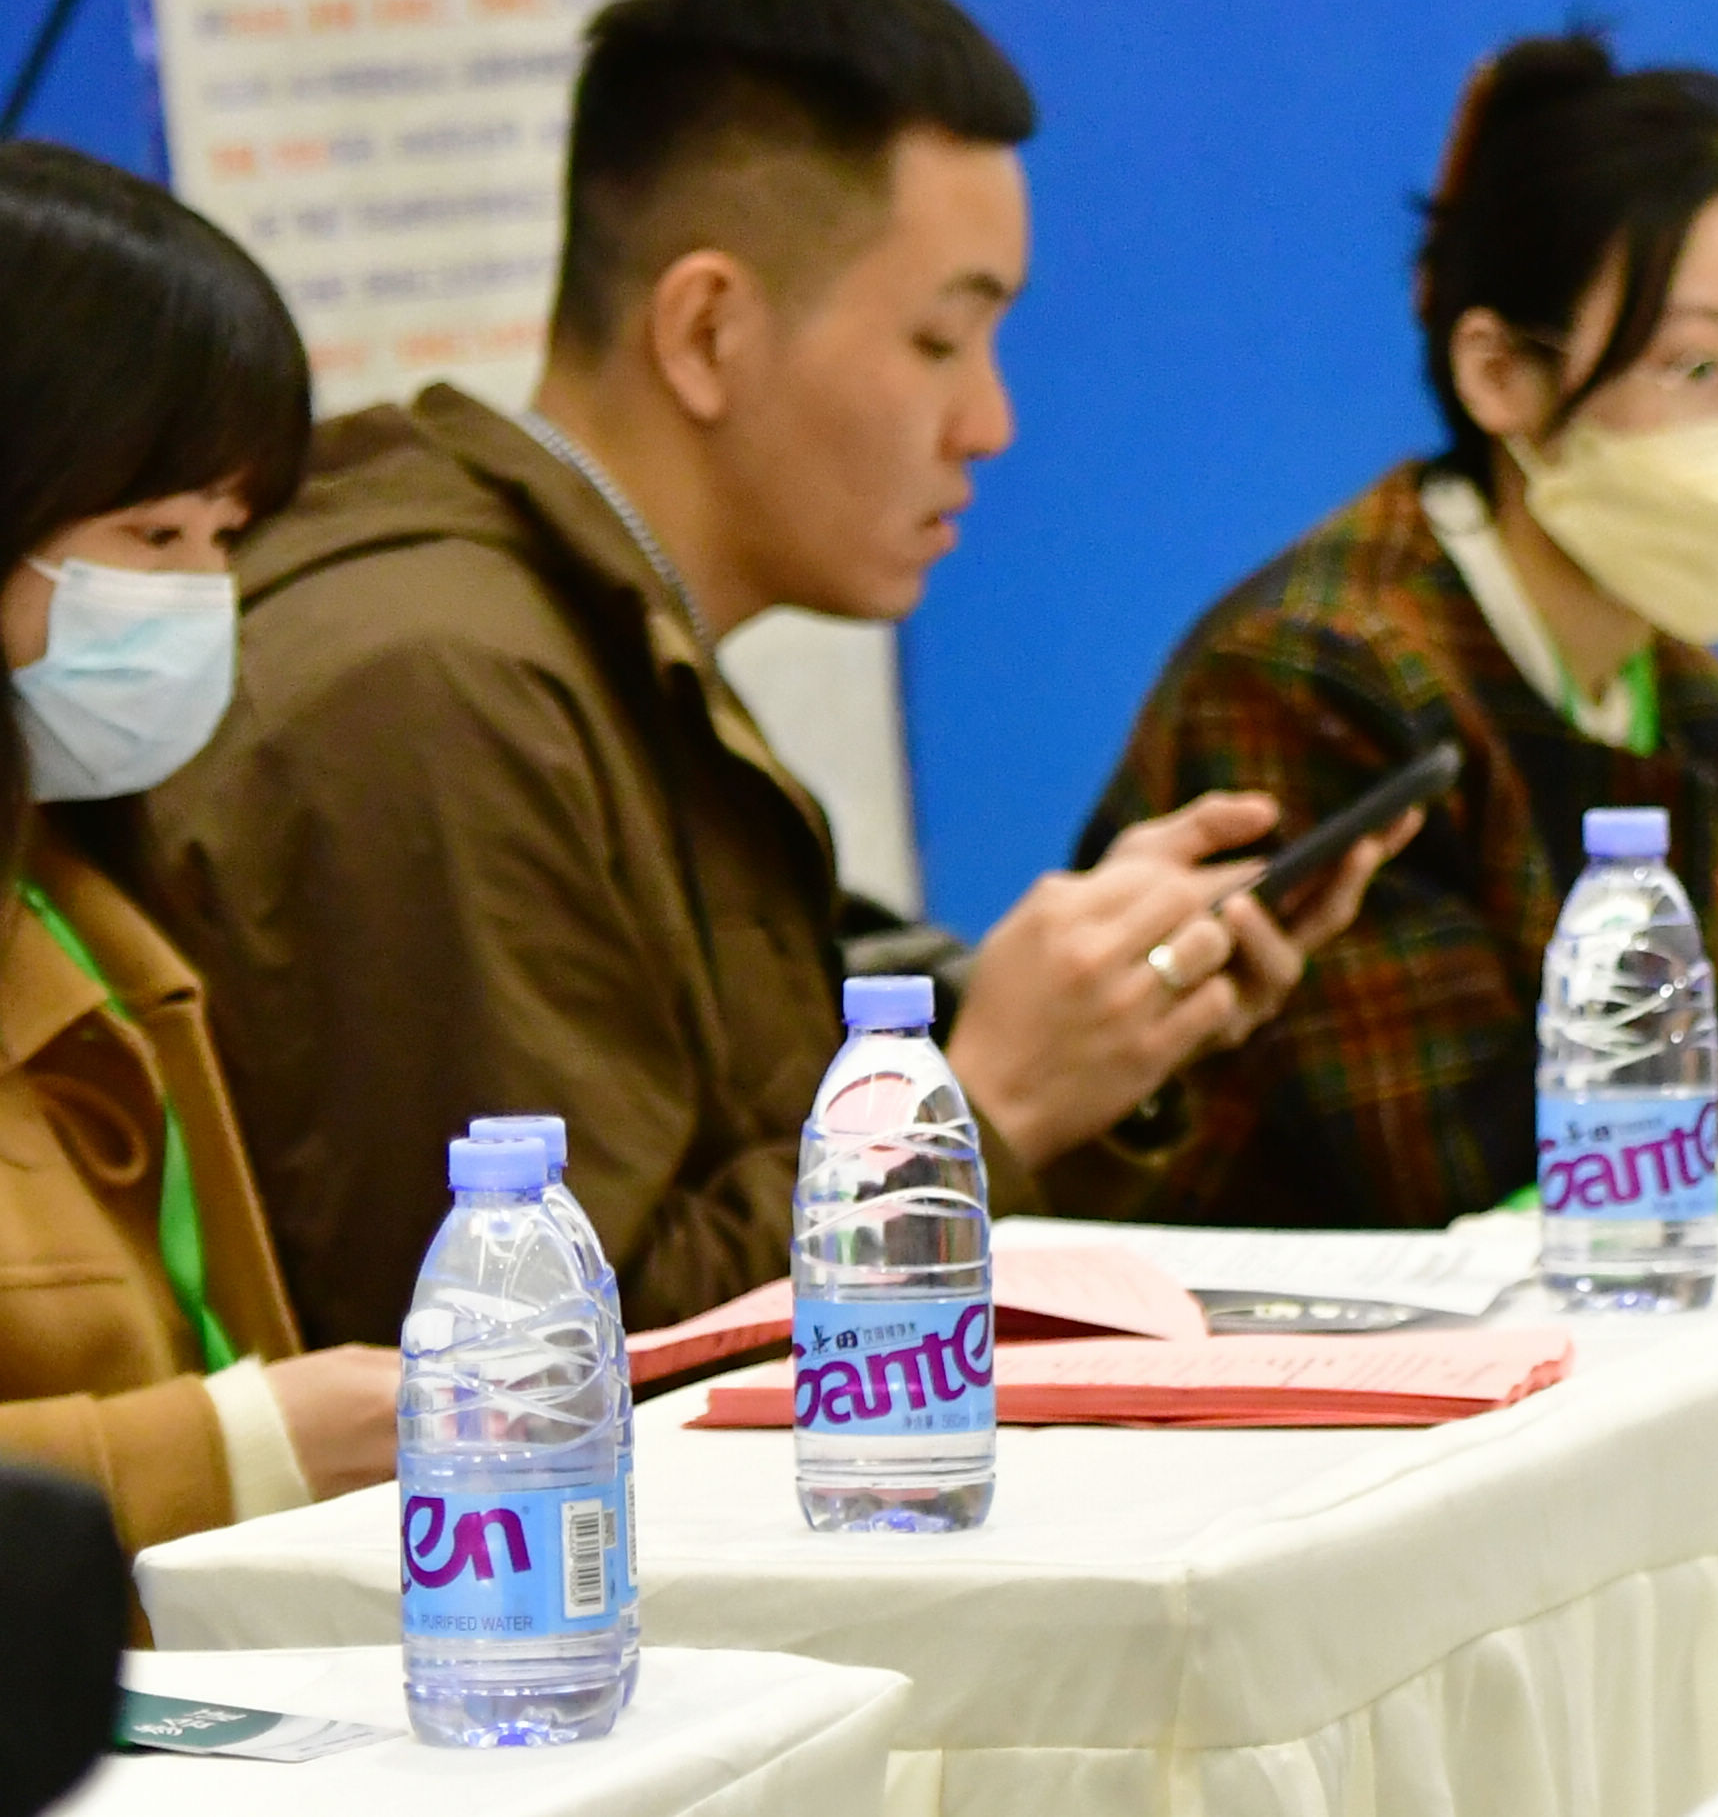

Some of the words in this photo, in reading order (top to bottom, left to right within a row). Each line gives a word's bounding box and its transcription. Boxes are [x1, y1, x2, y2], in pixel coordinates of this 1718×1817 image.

[401, 1496, 532, 1594] en
[420, 1614, 478, 1632] PURIFIED
[482, 1614, 534, 1632] WATER
